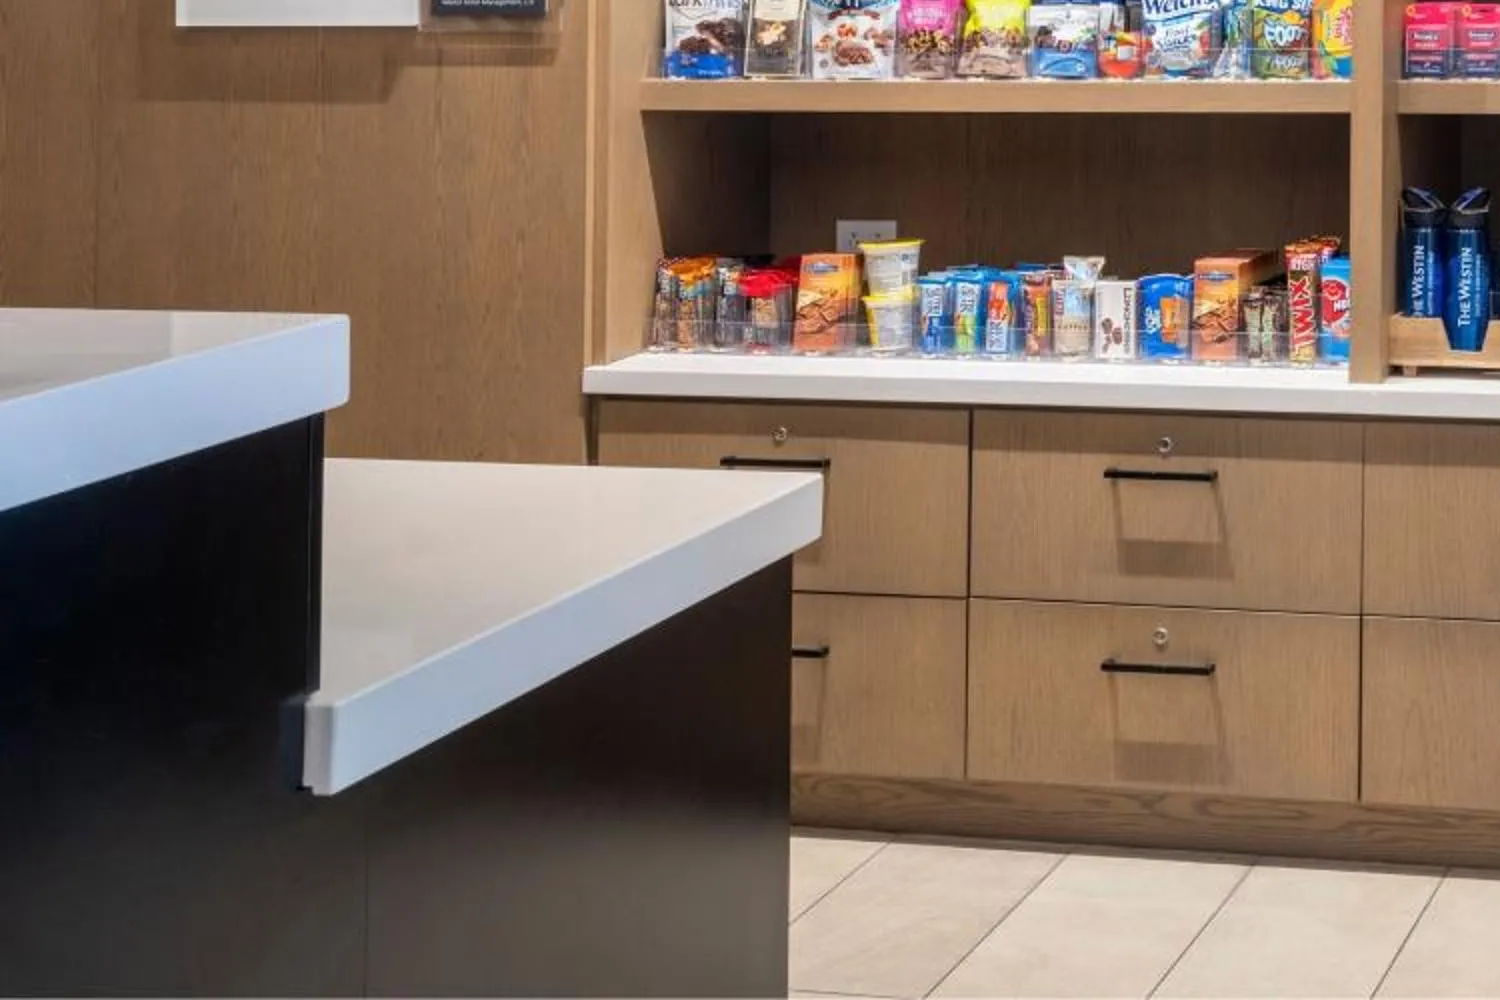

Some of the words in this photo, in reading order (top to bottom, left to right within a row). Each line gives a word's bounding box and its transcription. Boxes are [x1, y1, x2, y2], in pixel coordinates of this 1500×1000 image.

[1411, 245, 1425, 298] WESTIN
[1457, 247, 1473, 300] WESTIN
[1457, 301, 1471, 328] THE
